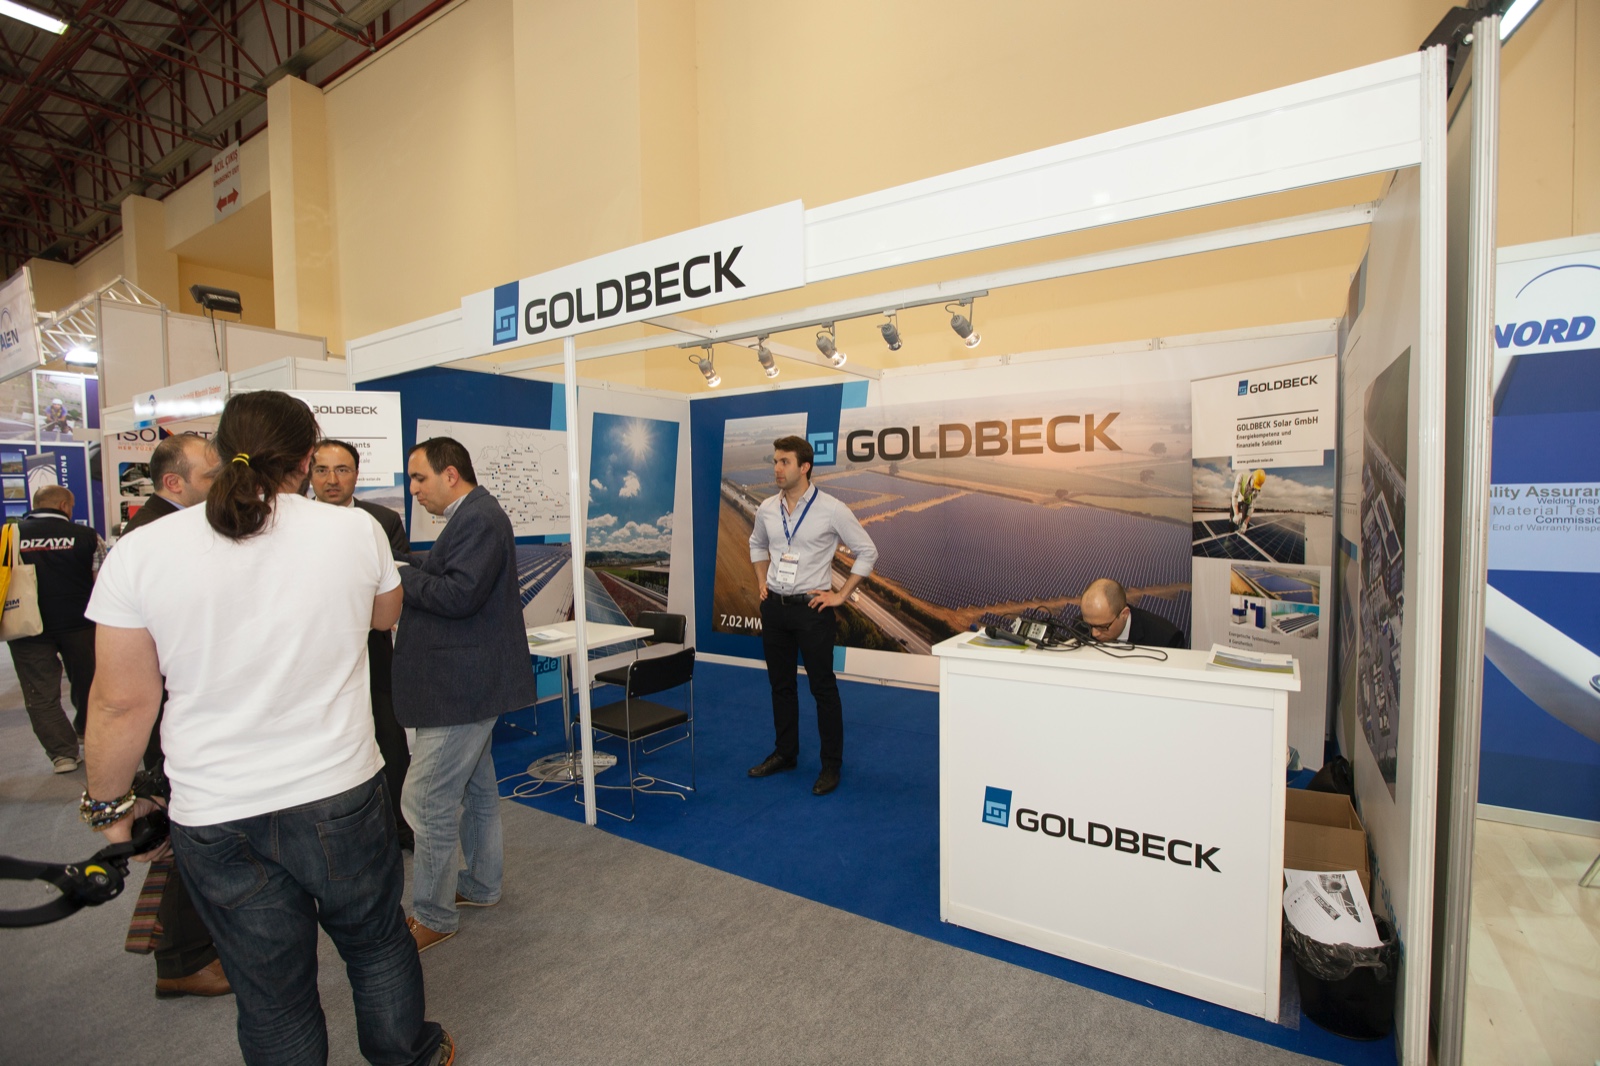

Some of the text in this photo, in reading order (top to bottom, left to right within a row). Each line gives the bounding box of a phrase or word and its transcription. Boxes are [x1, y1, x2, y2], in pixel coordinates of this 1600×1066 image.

[524, 245, 747, 335] GOLDBECK
[1494, 315, 1596, 349] NORD
[1249, 374, 1319, 394] GOLDBECK
[1236, 416, 1319, 432] GOLDBECK Solar GmbH
[846, 412, 1123, 463] GOLDBECK
[1236, 431, 1280, 441] Energiekompetenz
[1236, 441, 1260, 449] finanzielle
[1490, 486, 1521, 501] lity
[1537, 497, 1576, 505] Welding
[1492, 505, 1559, 516] Material
[1526, 524, 1572, 533] Warranty
[720, 614, 742, 628] 7.02
[1015, 807, 1222, 873] GOLDBECK
